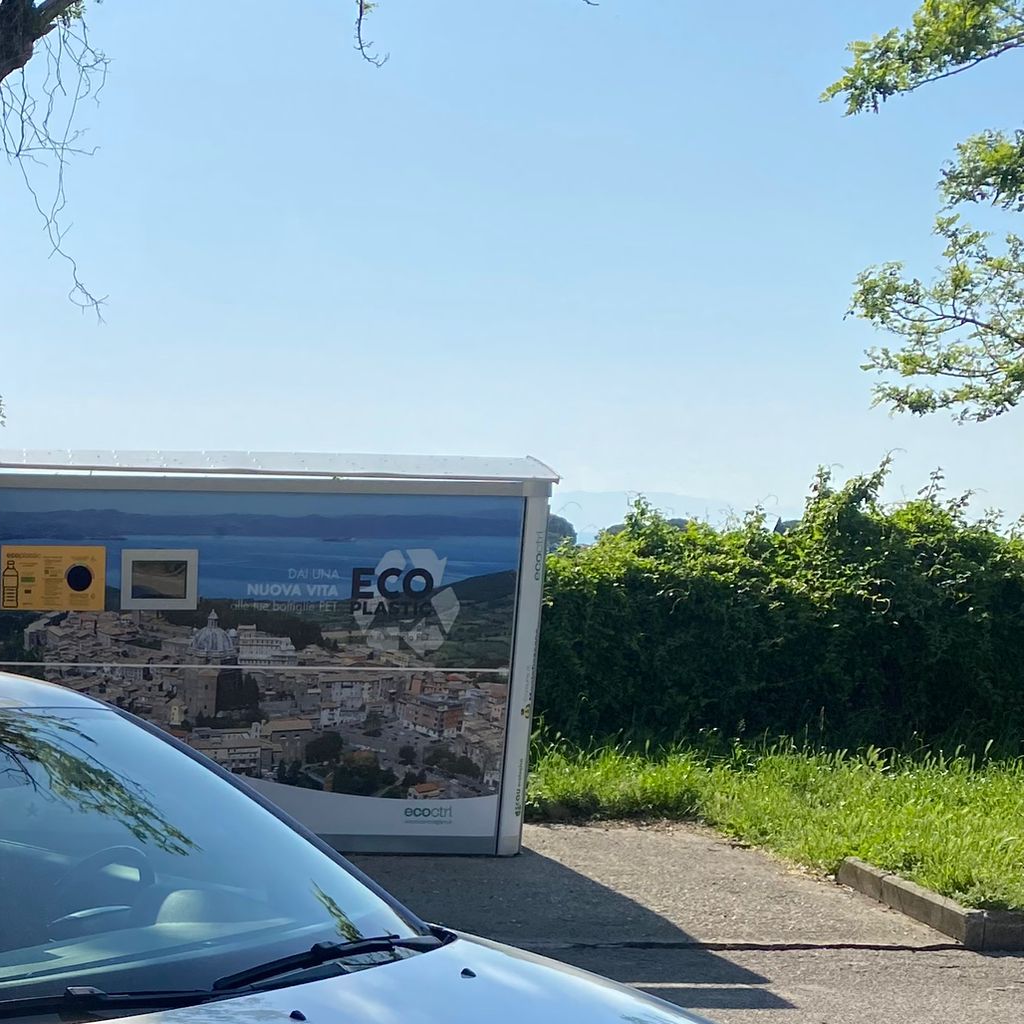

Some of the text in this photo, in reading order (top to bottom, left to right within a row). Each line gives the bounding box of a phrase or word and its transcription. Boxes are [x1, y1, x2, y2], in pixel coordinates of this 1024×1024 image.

[288, 568, 339, 579] DAI UNA
[247, 583, 338, 597] NUOVA VITA
[351, 567, 434, 600] ECO
[404, 805, 453, 818] ecoctrl
